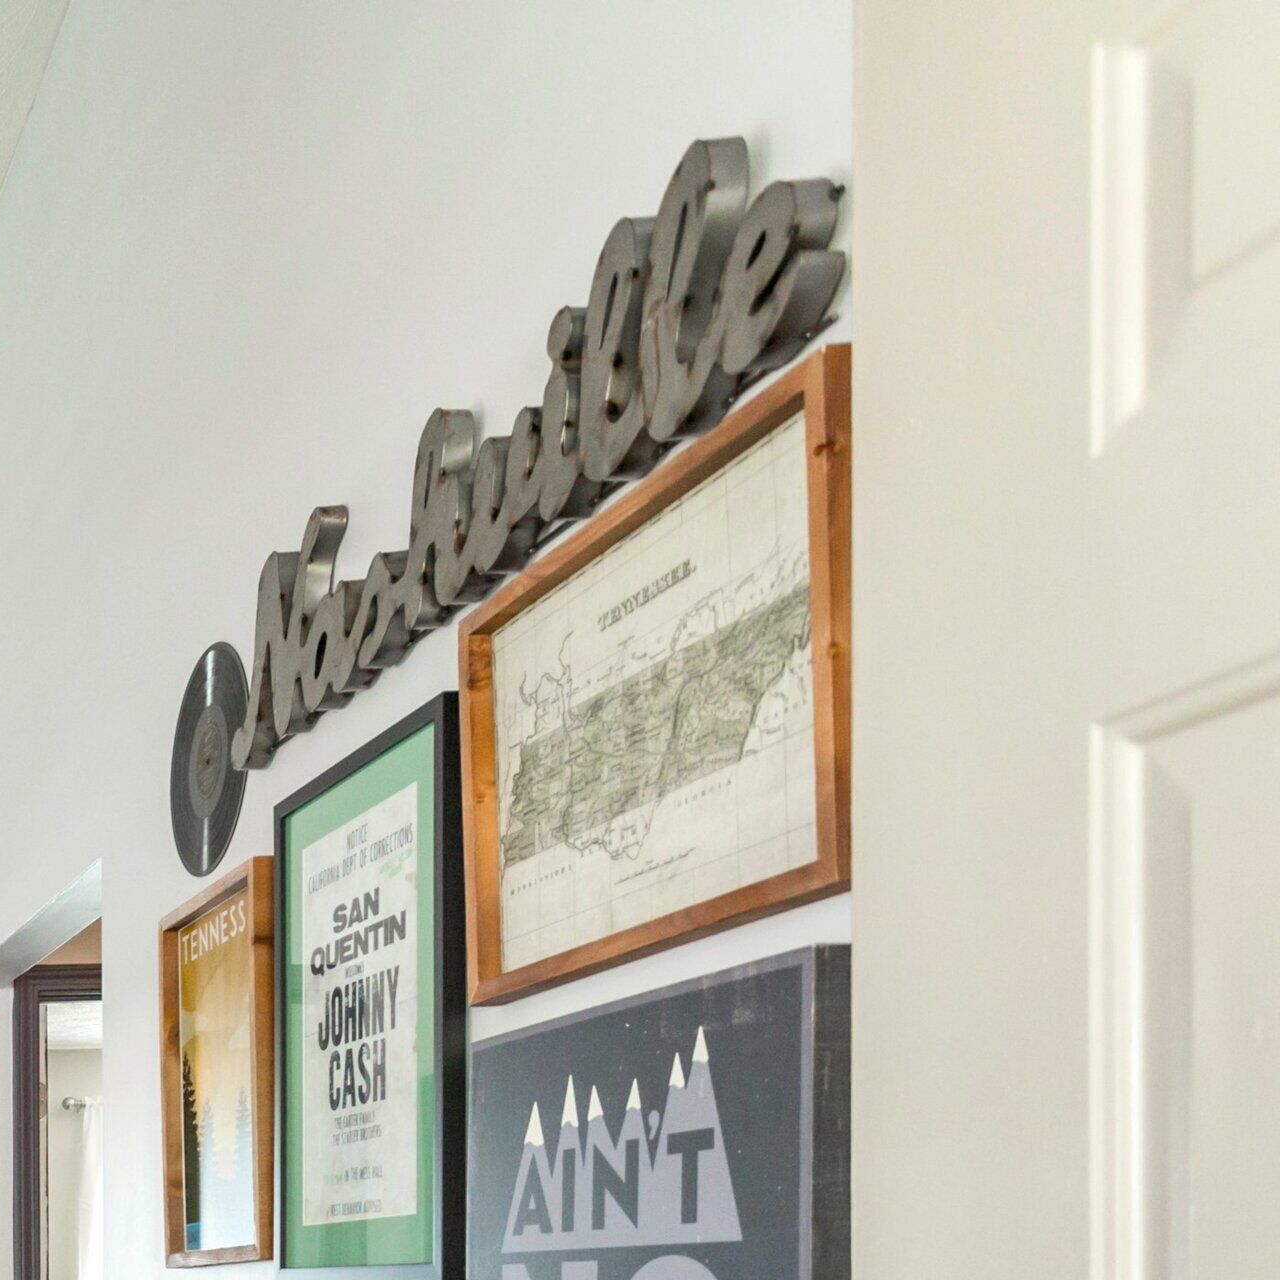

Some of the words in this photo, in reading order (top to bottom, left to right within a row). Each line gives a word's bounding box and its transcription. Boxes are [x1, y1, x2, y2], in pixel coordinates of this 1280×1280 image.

[231, 136, 846, 771] Nashville
[308, 861, 340, 895] CALIFORNIA
[342, 854, 357, 877] DEPT
[359, 848, 369, 867] OF
[370, 822, 414, 862] CORRECTIONS
[346, 823, 368, 848] NOTICE
[181, 901, 246, 965] TENNESS
[310, 909, 407, 977] QUENTIN
[332, 887, 380, 934] SAN
[318, 965, 400, 1050] JOHNNY
[328, 1038, 387, 1111] CASH
